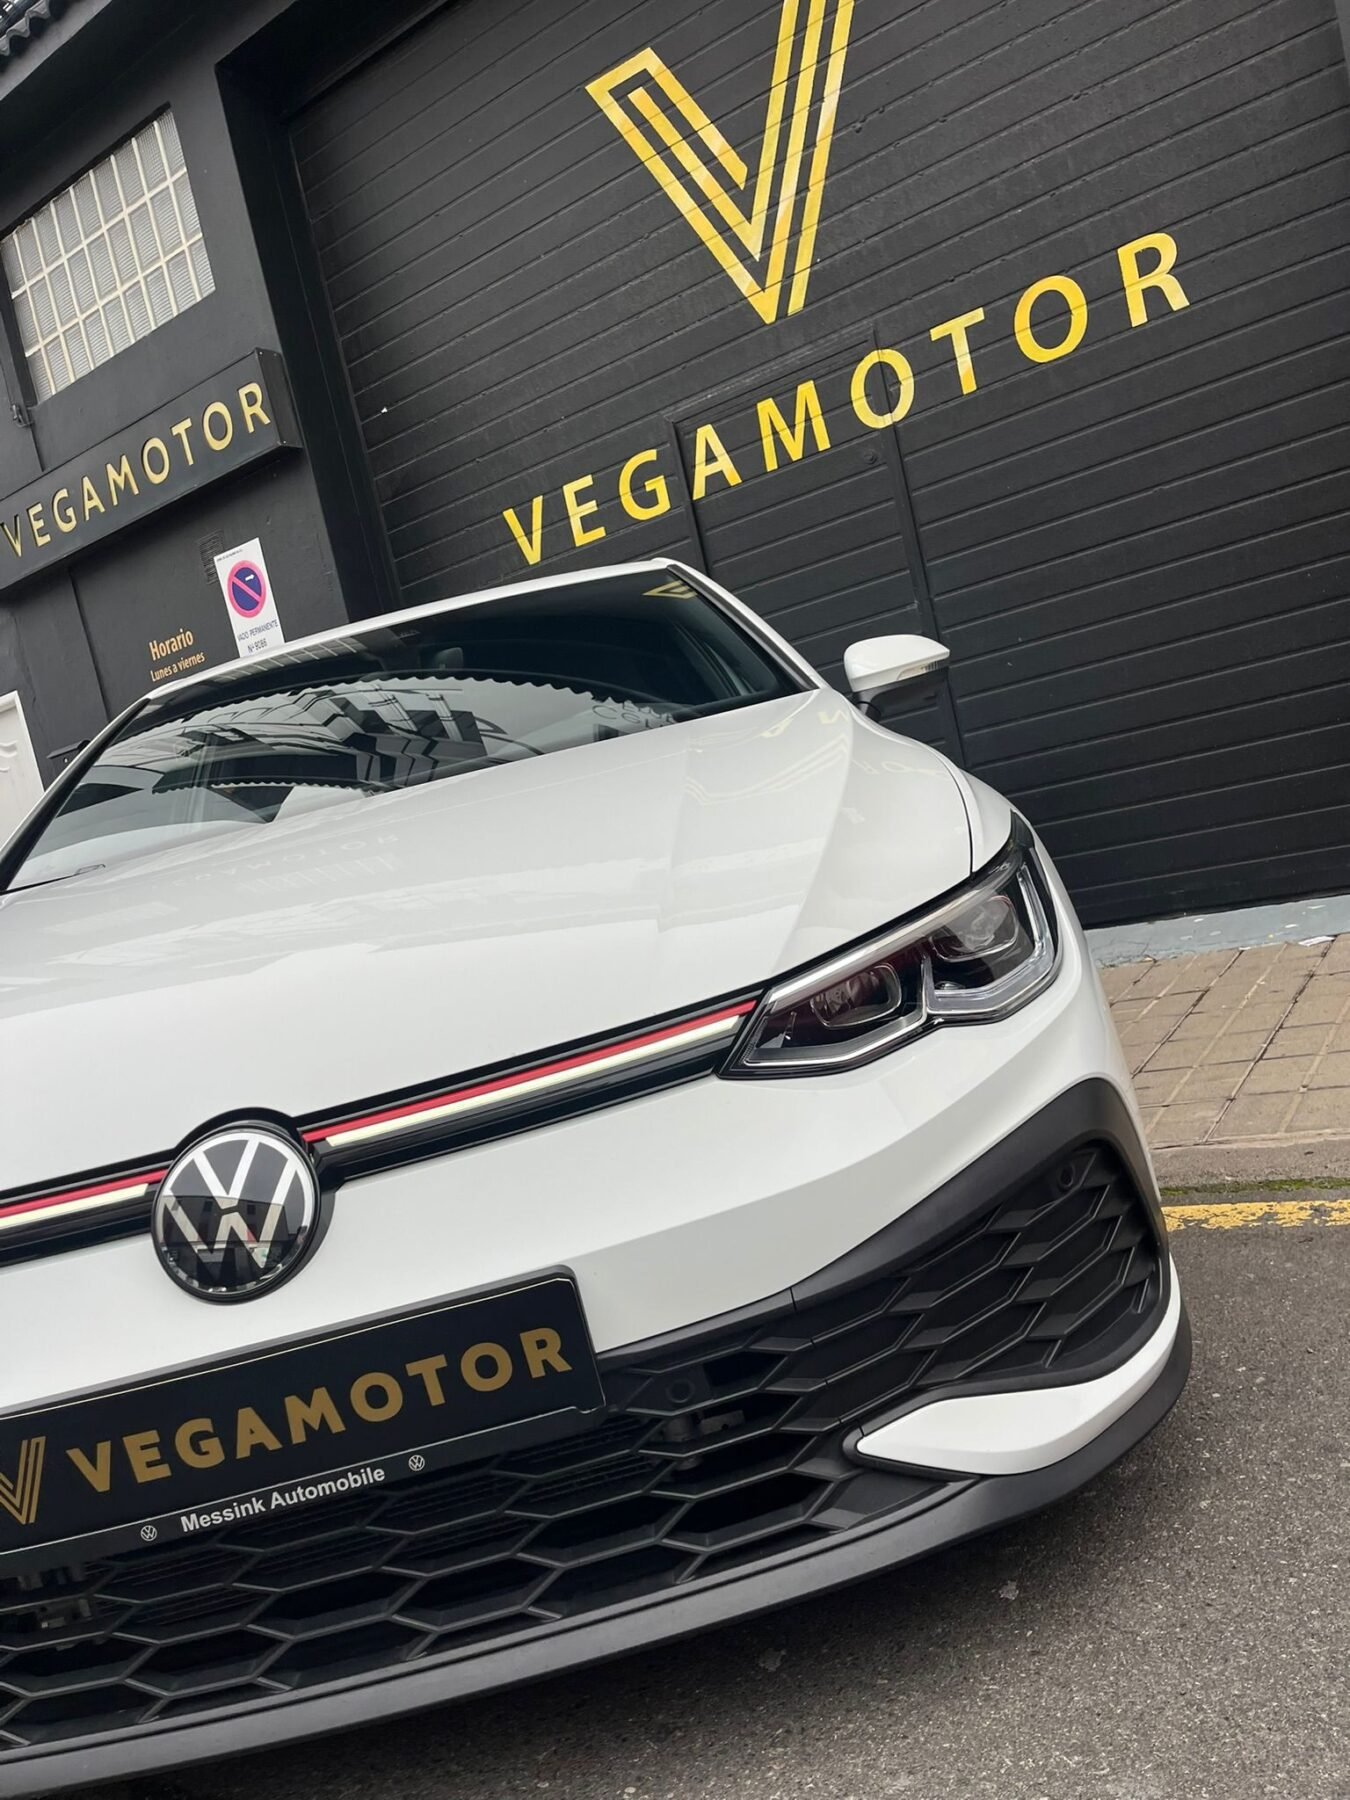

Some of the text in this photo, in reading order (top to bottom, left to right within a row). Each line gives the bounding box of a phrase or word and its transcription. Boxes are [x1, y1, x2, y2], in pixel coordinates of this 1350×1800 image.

[502, 232, 1191, 566] VEGAMOTOR
[0, 382, 271, 558] VEGAMOTOR
[149, 628, 194, 661] Horario
[150, 652, 206, 682] Lunes a viernes
[66, 1326, 573, 1493] VEGAMOTOR
[181, 1497, 266, 1533] Messink
[270, 1466, 386, 1510] Automobile
